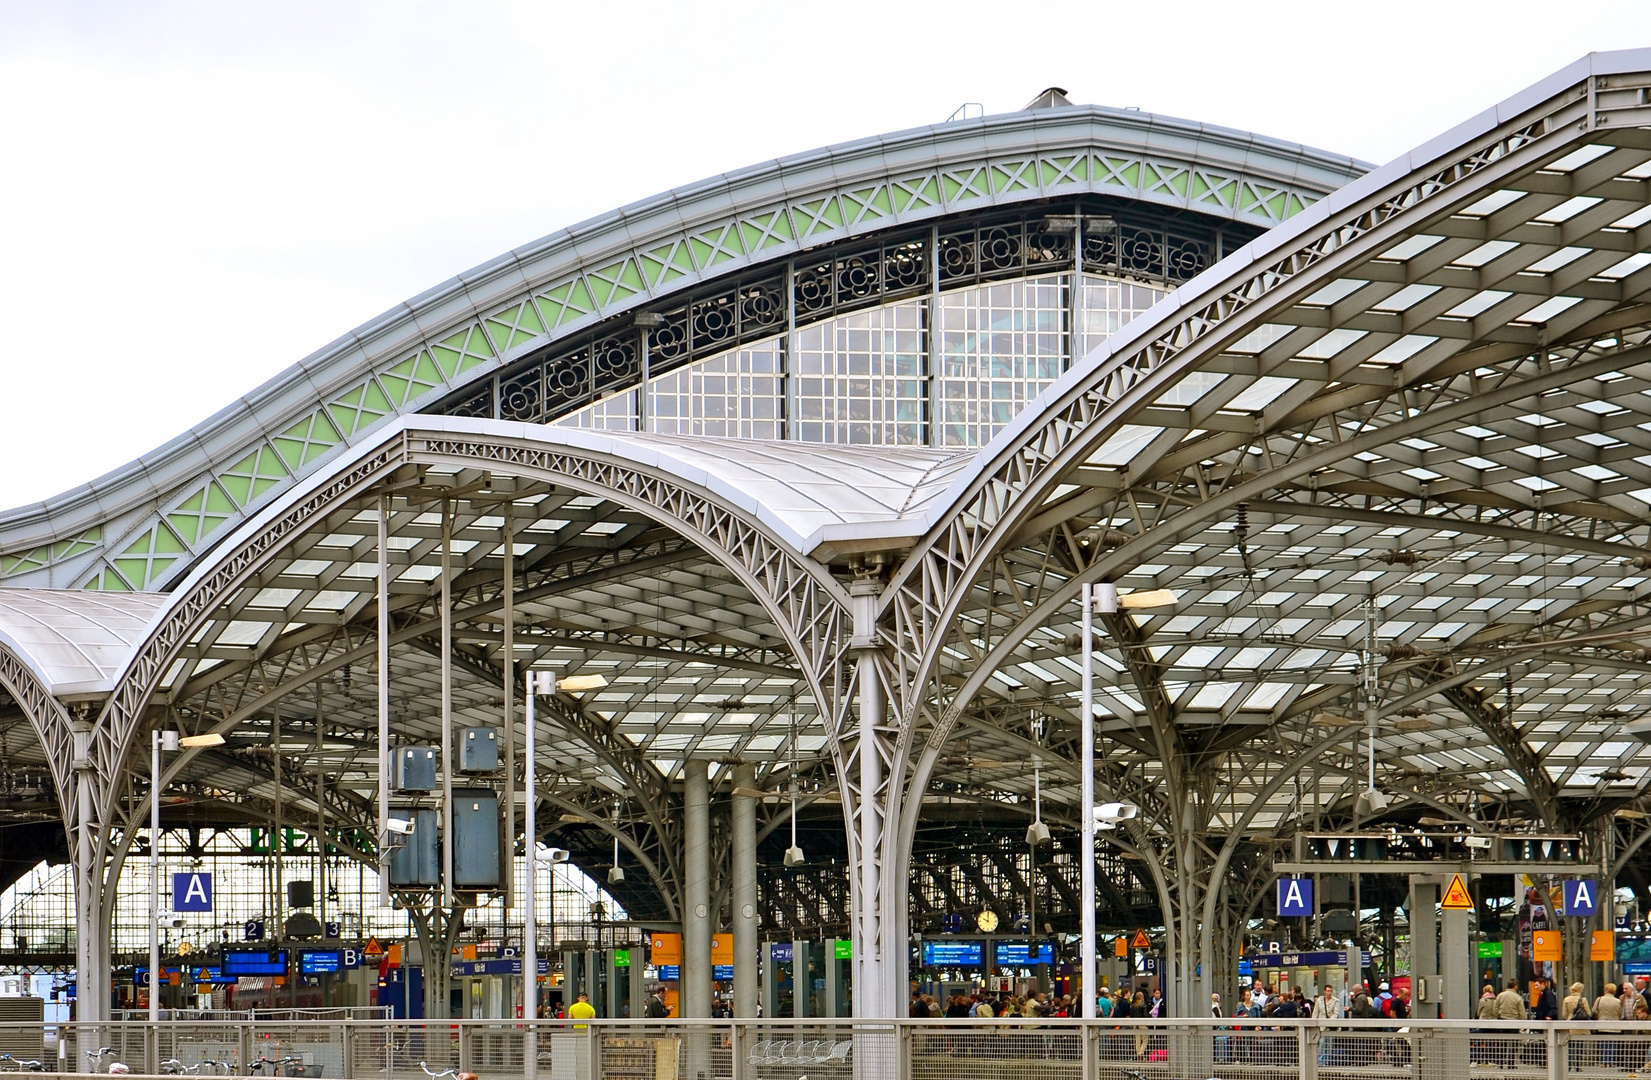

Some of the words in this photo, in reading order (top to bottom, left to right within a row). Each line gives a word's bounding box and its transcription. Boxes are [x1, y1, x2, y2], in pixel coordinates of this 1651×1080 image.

[184, 874, 208, 903] A
[1284, 880, 1304, 908] A
[1573, 881, 1593, 908] A
[247, 922, 257, 936] 2
[329, 922, 339, 936] 3
[344, 949, 356, 968] B
[1147, 959, 1154, 969] B
